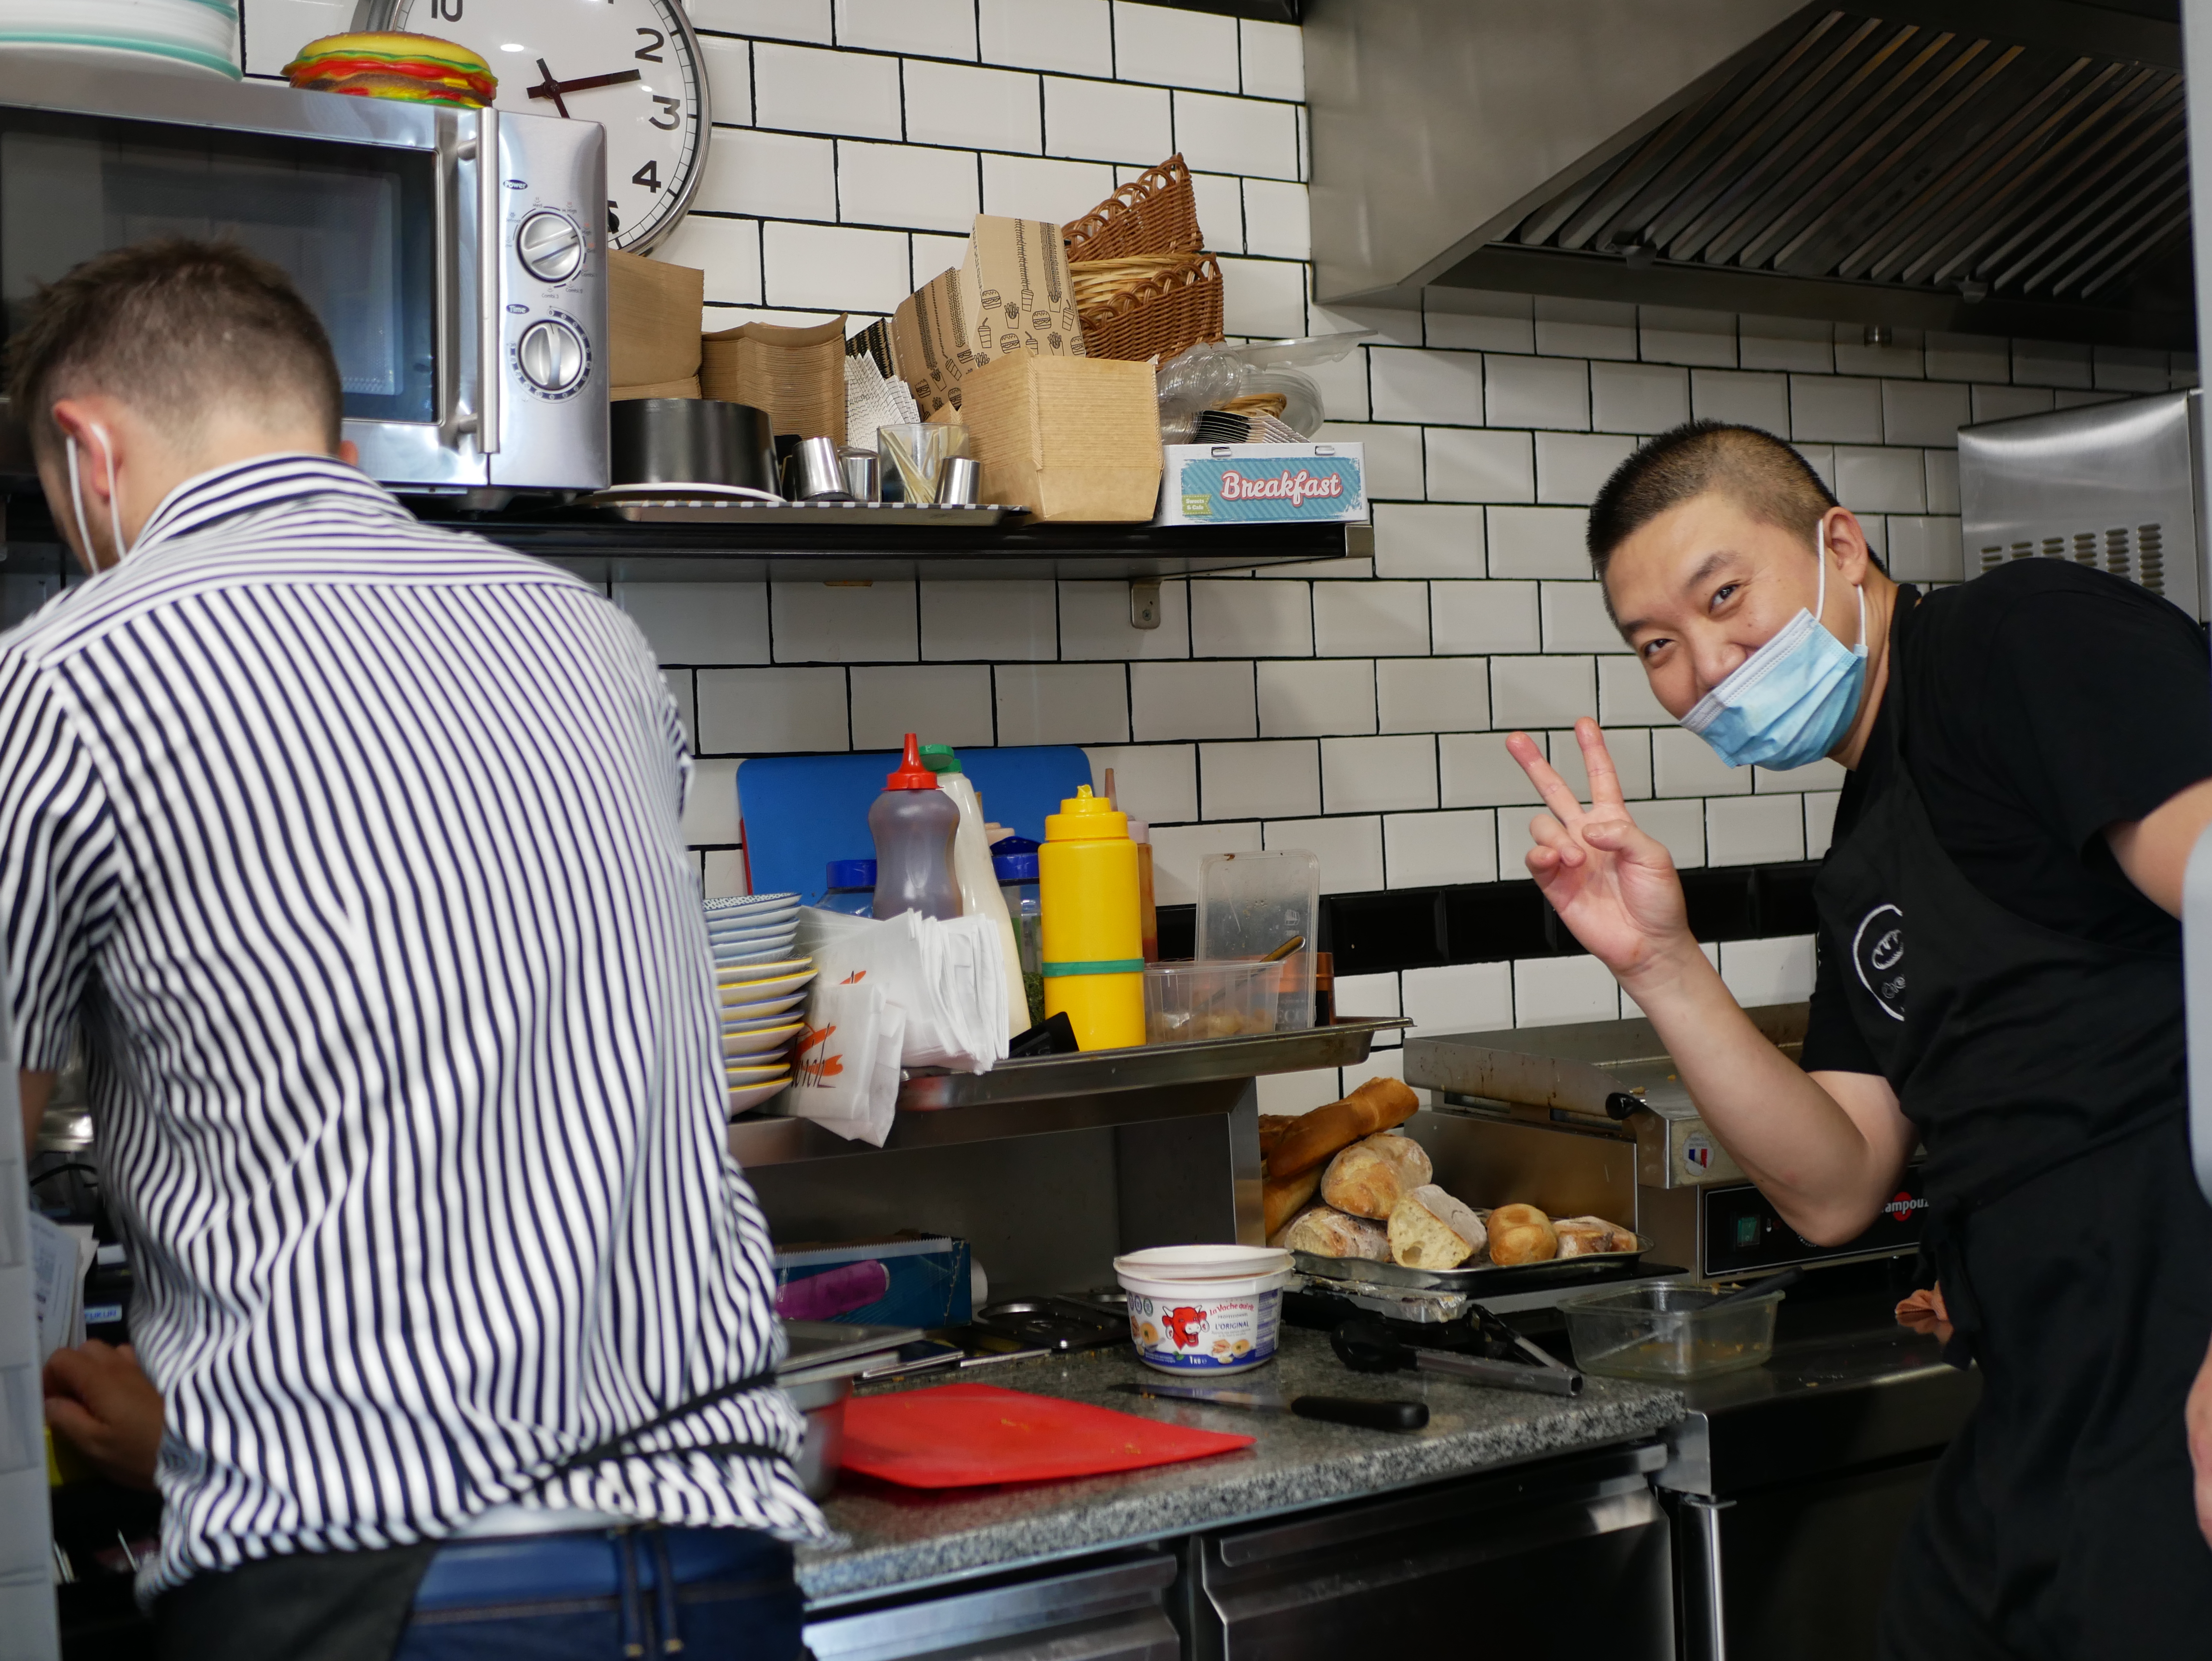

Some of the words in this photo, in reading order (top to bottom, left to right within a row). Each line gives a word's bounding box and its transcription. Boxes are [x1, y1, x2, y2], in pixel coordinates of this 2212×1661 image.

[432, 0, 462, 22] 10
[635, 27, 664, 63] 2
[648, 95, 680, 131] 3
[505, 181, 527, 189] Power
[632, 160, 661, 194] 4
[1221, 470, 1343, 506] Breakfast
[1882, 1199, 1929, 1215] ampouz
[1217, 1303, 1238, 1312] Vache
[1215, 1320, 1249, 1330] L'ORIGINAL
